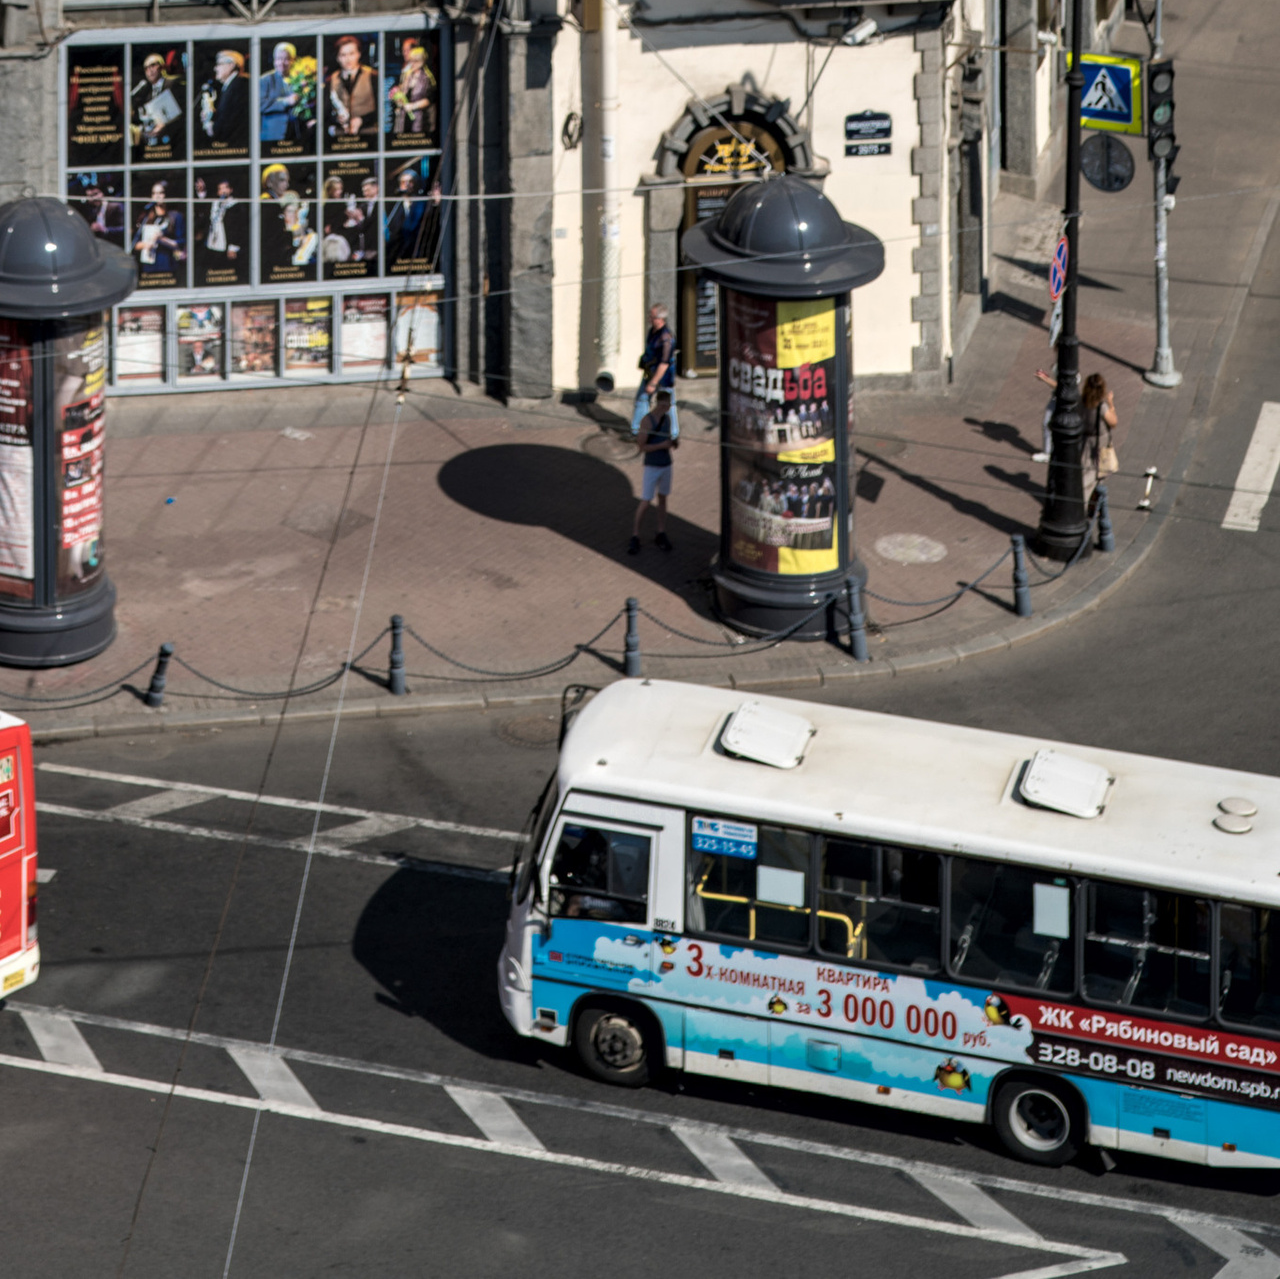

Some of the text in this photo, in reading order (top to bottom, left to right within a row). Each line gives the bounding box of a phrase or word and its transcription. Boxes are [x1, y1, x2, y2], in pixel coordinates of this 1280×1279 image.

[728, 357, 827, 404] свадьба
[816, 966, 891, 993] КВАРТИРА
[795, 989, 992, 1048] за 3 000 000 руб.
[1038, 1005, 1278, 1067] ЖК «Рябиновый сад»
[1038, 1042, 1156, 1081] 328-08-08
